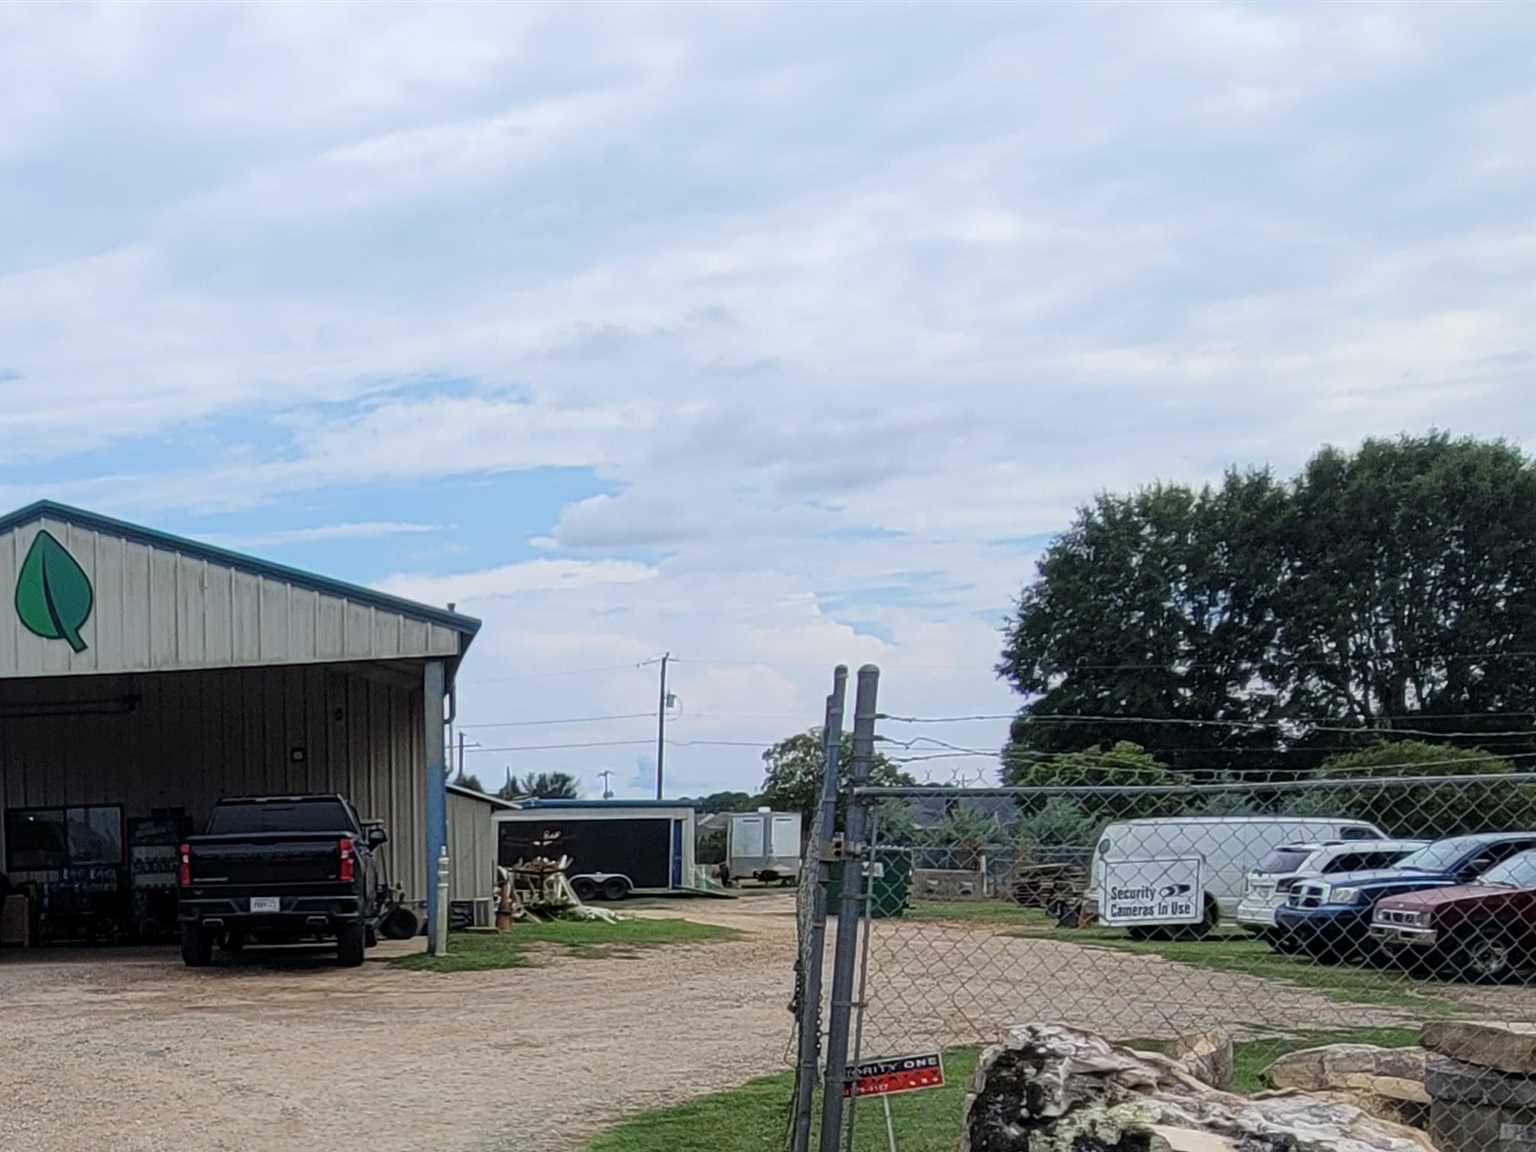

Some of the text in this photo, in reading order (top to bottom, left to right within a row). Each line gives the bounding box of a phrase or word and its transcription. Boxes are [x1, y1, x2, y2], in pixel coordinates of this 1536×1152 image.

[1111, 885, 1156, 901] Security
[1111, 902, 1191, 917] Cameras In Use
[904, 1057, 937, 1069] ONE
